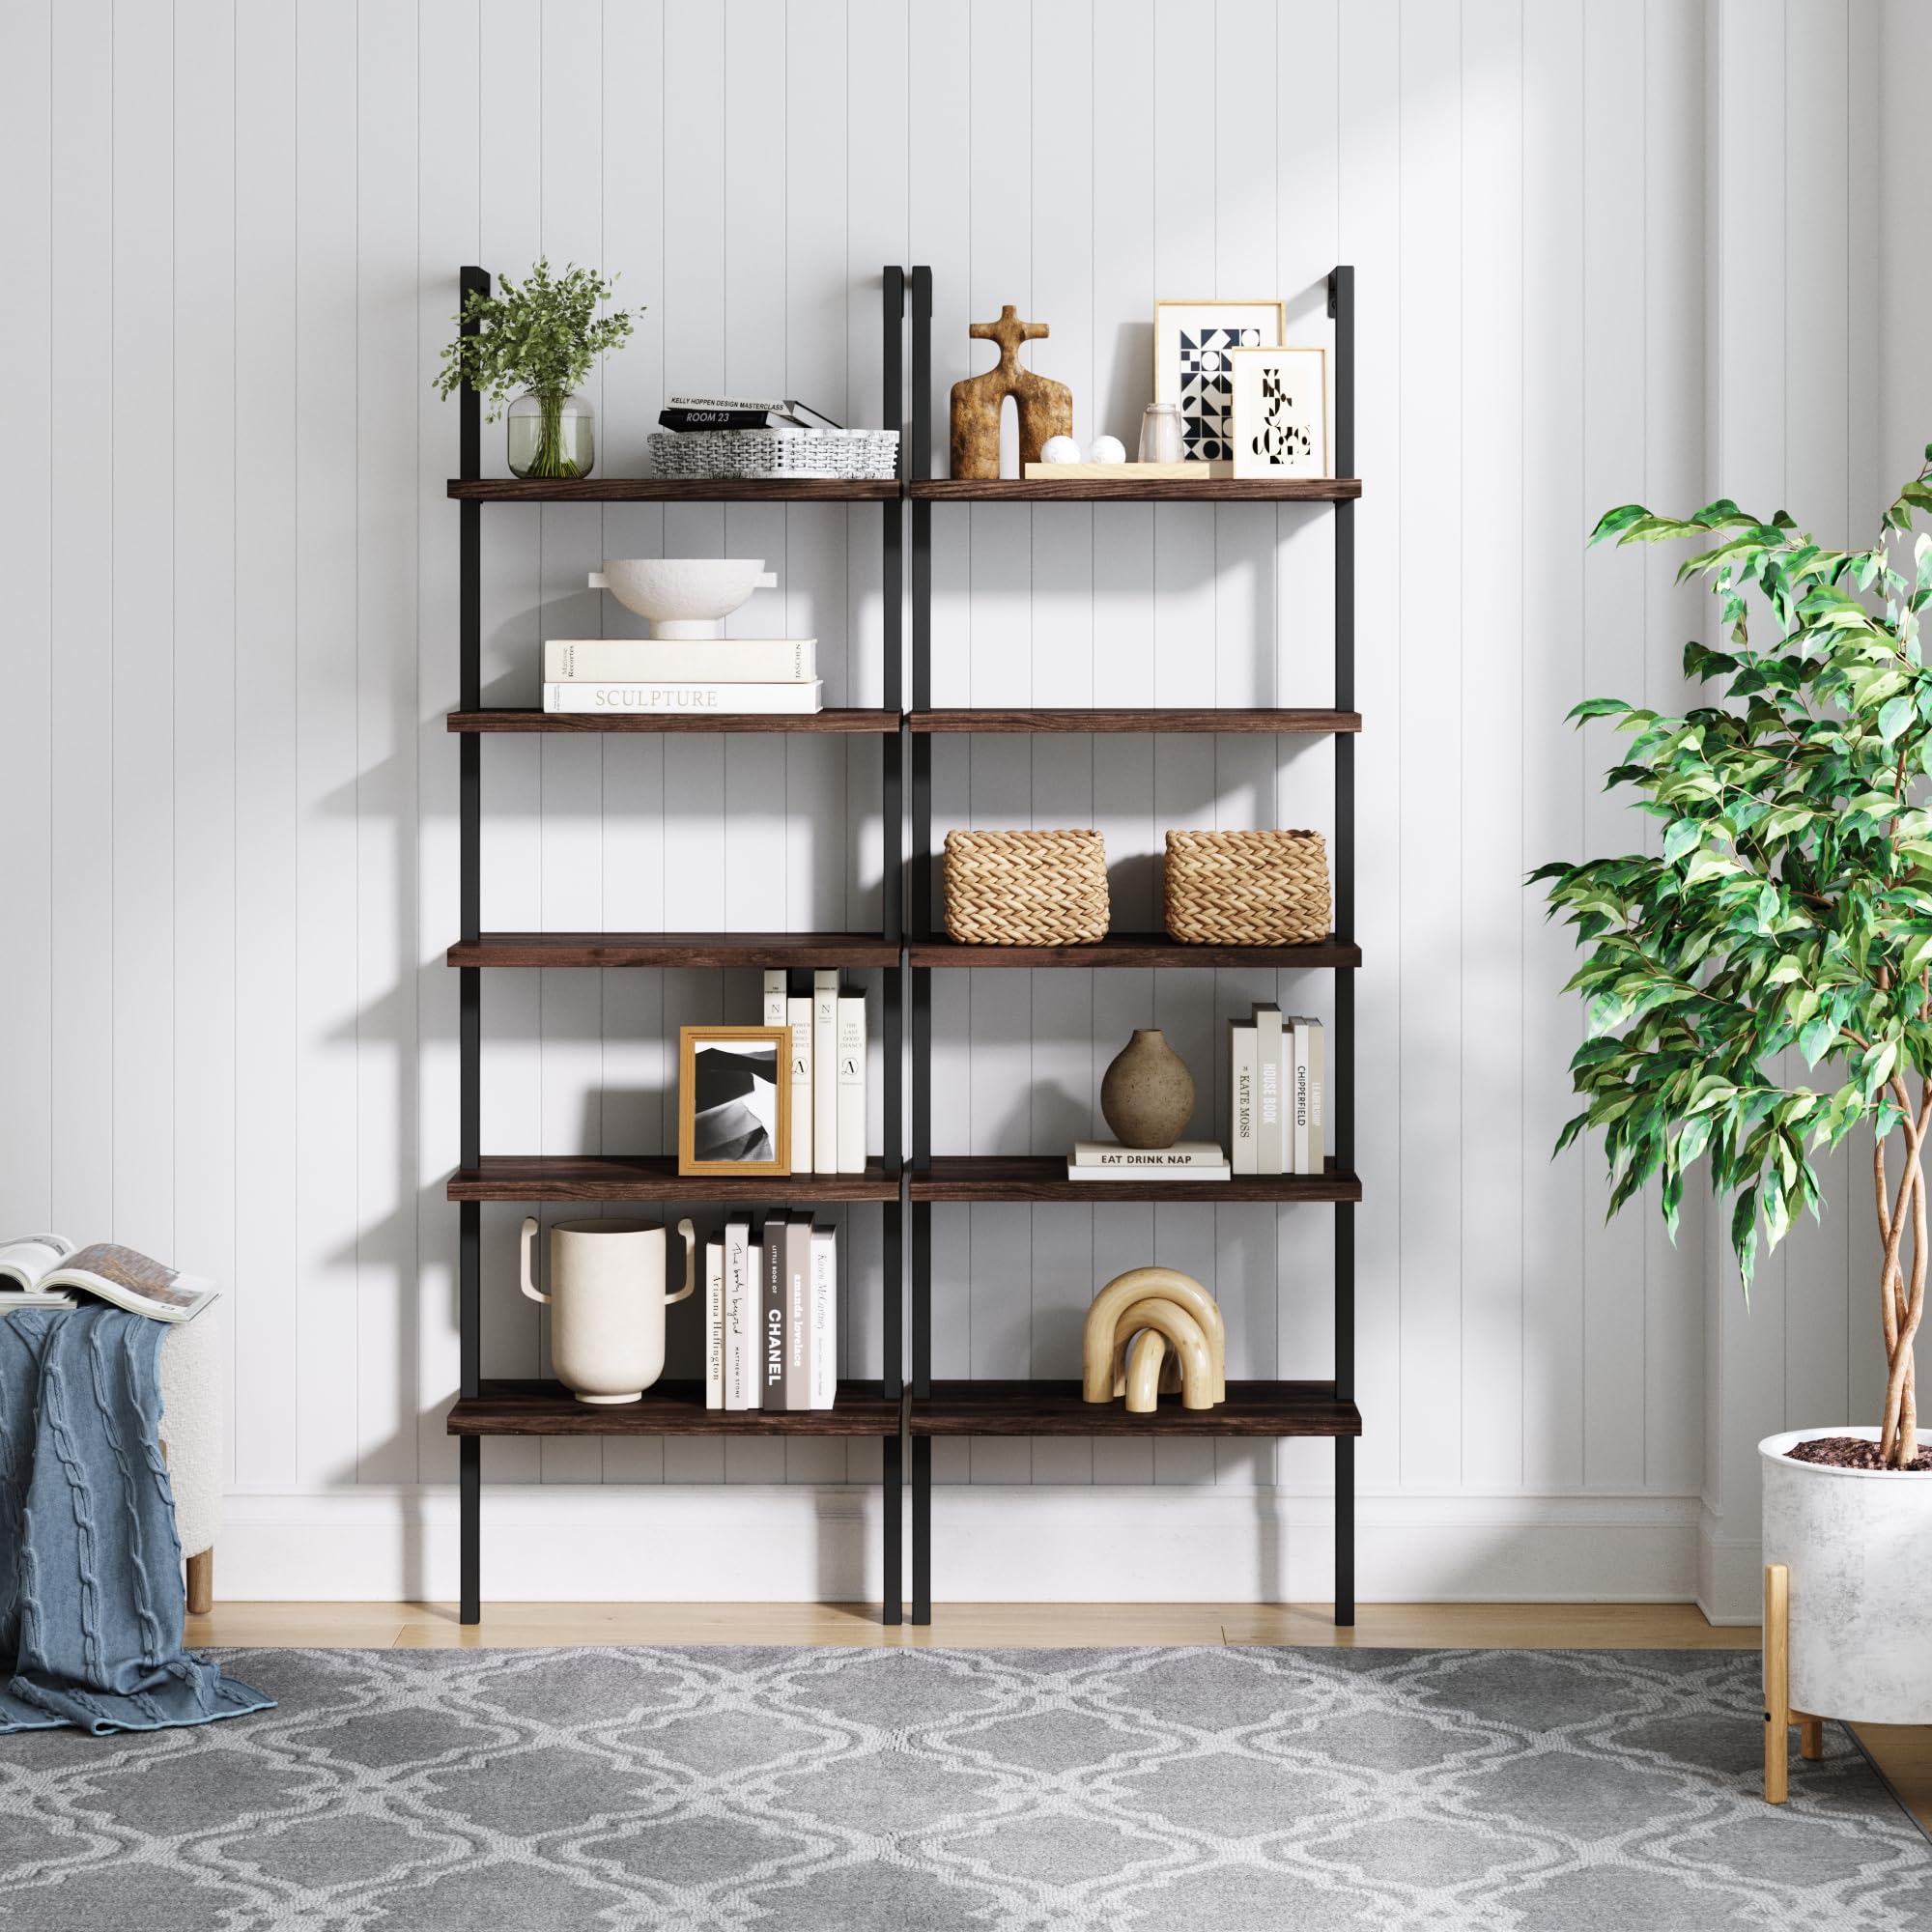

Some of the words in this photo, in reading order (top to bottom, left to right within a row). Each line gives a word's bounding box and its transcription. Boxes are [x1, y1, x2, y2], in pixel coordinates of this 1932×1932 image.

[686, 412, 716, 422] ROOM
[718, 412, 729, 422] 23
[739, 402, 784, 411] MASTERCLASS
[595, 690, 718, 707] SCULPTURE
[771, 1004, 781, 1013] N
[821, 1004, 831, 1013] N
[1239, 1074, 1250, 1105] KATE
[1263, 1064, 1276, 1095] HOUSE
[1263, 1097, 1276, 1124] BOOK
[1297, 1065, 1306, 1126] CHIPPERFIELD
[1239, 1107, 1250, 1138] MOSS
[1101, 1155, 1122, 1164] EAT
[1126, 1155, 1164, 1164] DRINK
[1168, 1155, 1192, 1164] NAP
[713, 1274, 722, 1318] Arianna
[772, 1285, 778, 1294] OF
[794, 1274, 803, 1318] amanda
[710, 1321, 723, 1381] Huffington
[768, 1309, 781, 1386] CHANEL
[794, 1321, 803, 1367] lovelace
